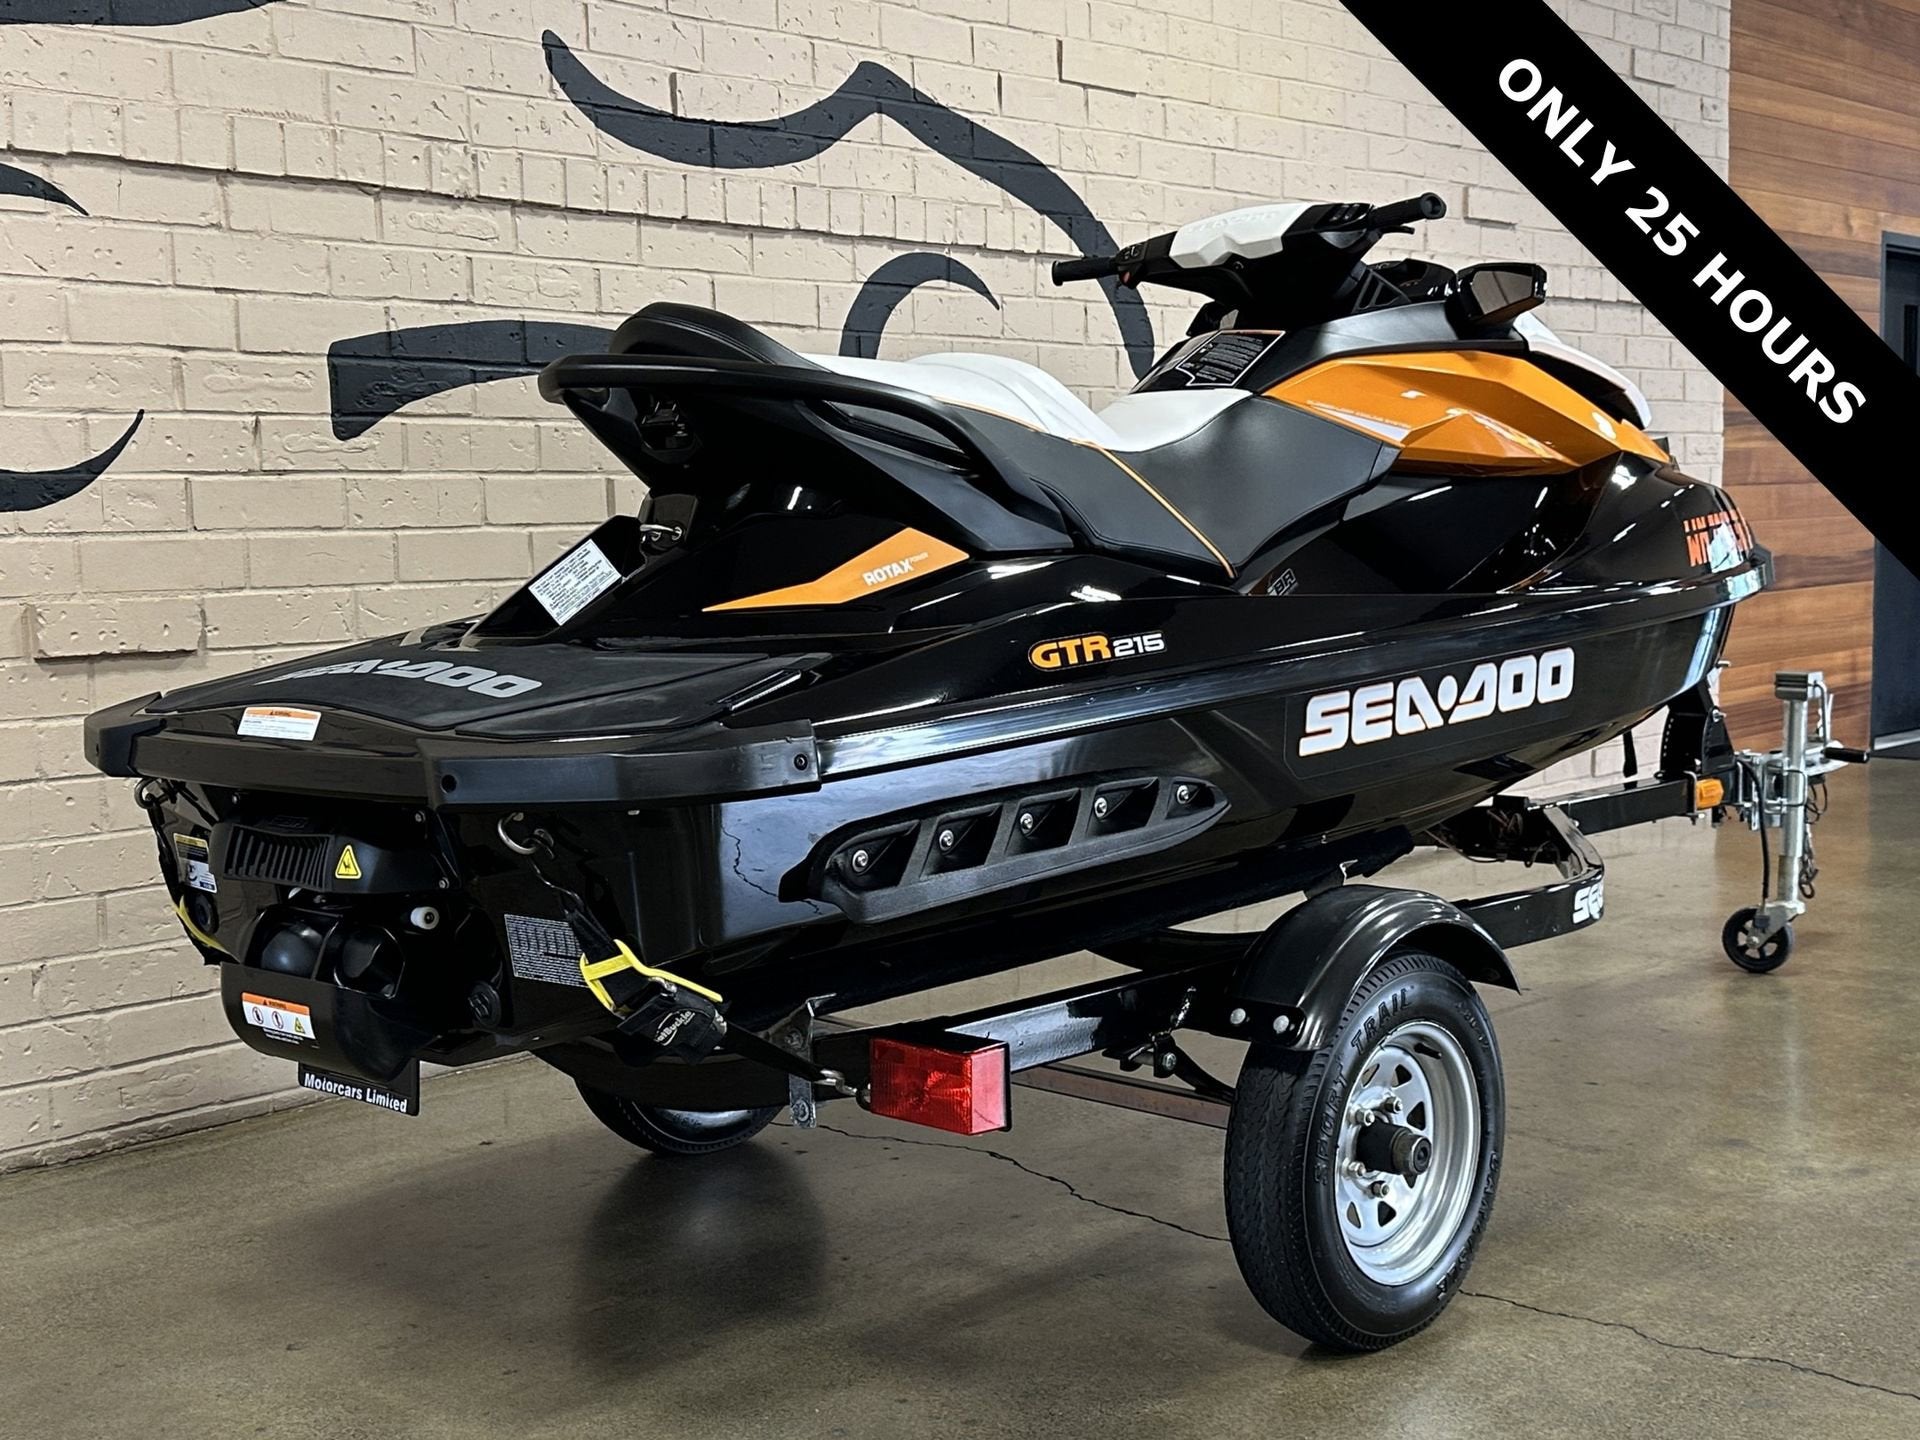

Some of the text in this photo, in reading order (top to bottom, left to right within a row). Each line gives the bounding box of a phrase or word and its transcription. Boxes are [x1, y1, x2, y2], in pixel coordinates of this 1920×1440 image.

[862, 558, 914, 586] ROTAX
[1030, 633, 1166, 668] GTR 215
[1351, 988, 1413, 1055] TRAIL
[304, 1072, 408, 1113] Motorcars Limited
